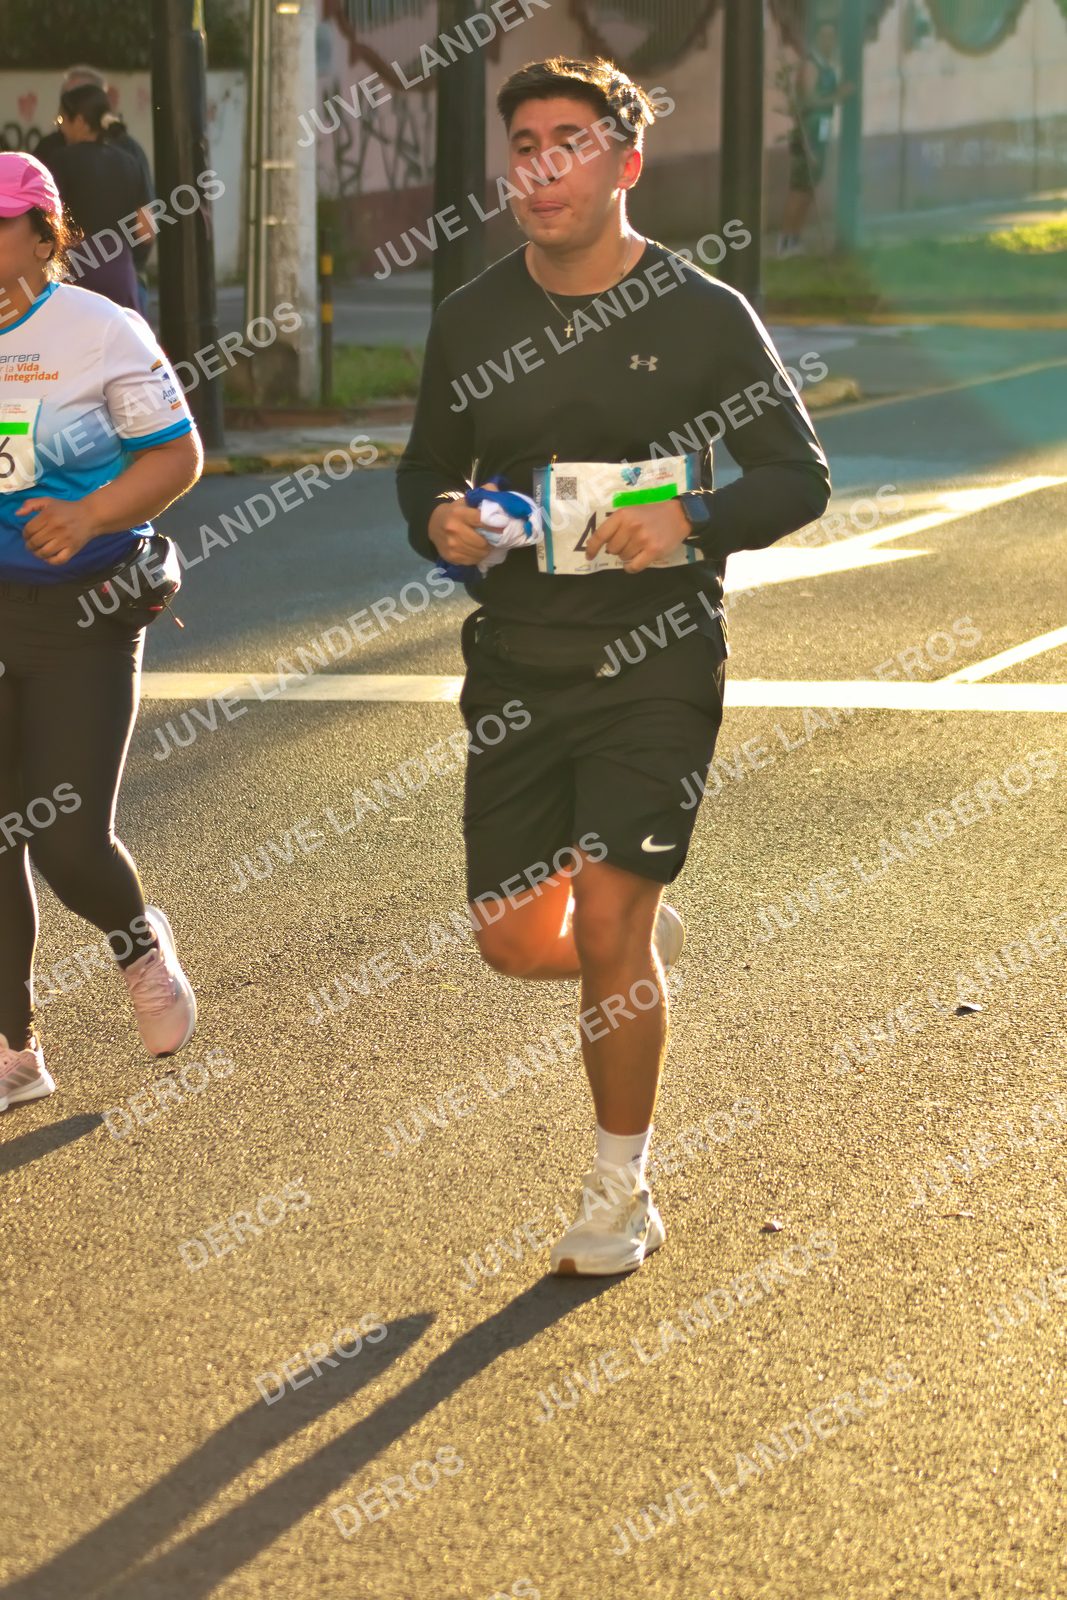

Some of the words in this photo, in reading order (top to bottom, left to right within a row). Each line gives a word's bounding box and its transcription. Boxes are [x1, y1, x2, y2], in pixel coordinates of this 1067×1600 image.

[0, 353, 40, 363] arrera
[17, 362, 40, 372] Vida
[4, 371, 59, 383] Integridad
